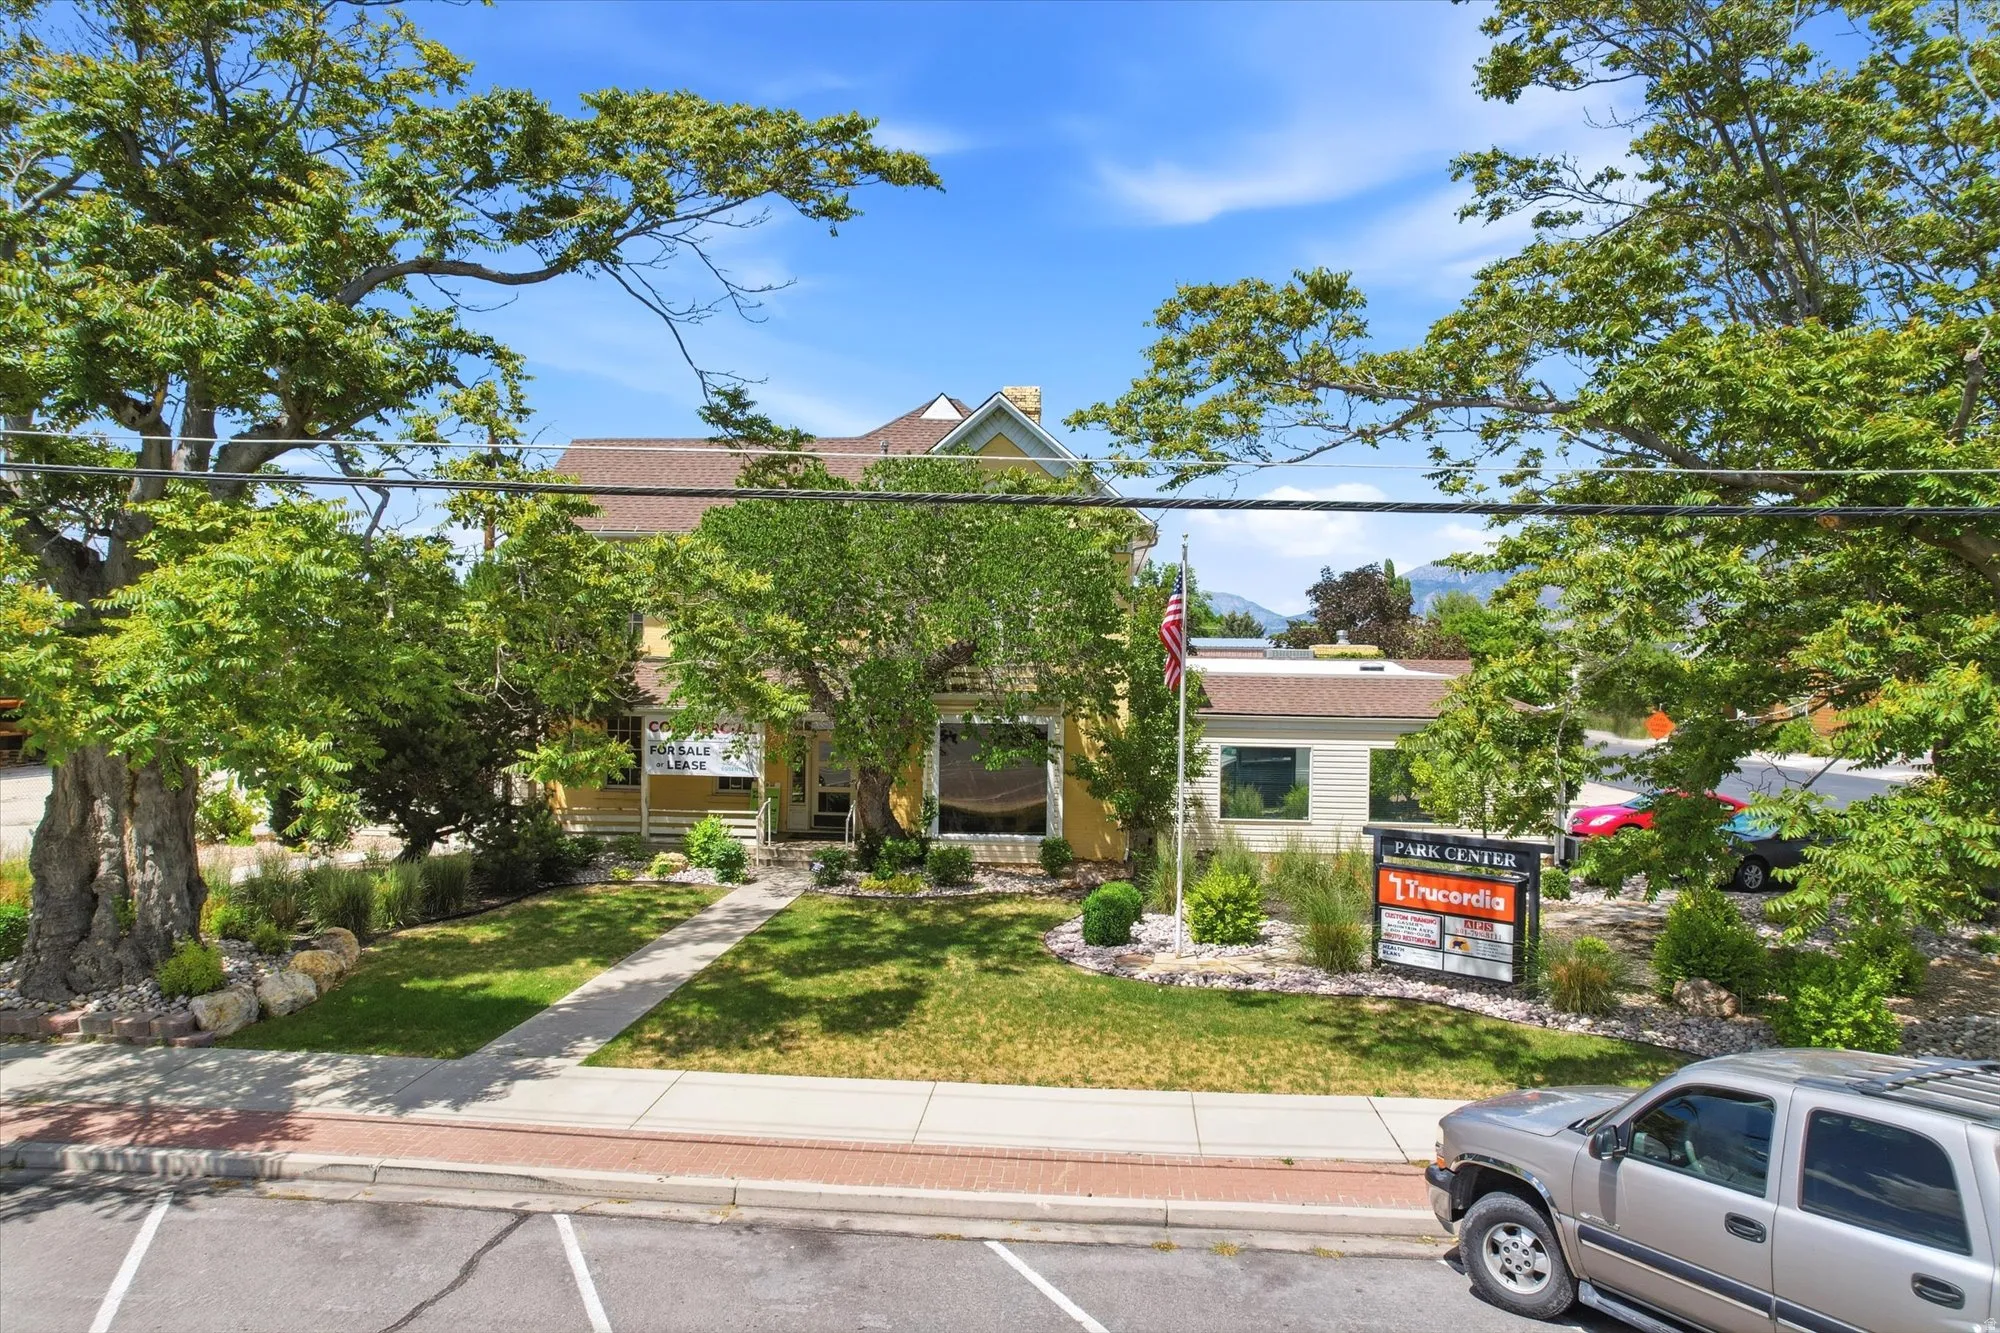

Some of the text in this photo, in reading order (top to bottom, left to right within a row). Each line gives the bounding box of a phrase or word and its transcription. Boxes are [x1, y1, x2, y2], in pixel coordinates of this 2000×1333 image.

[650, 745, 711, 756] FOR SALE
[667, 760, 707, 771] LEASE
[1394, 840, 1516, 867] PARK CENTER
[1405, 879, 1505, 911] Trucordia
[1385, 912, 1436, 925] CUSTOM FRAMING
[1464, 920, 1494, 932] APS
[1382, 944, 1405, 952] HEALTH
